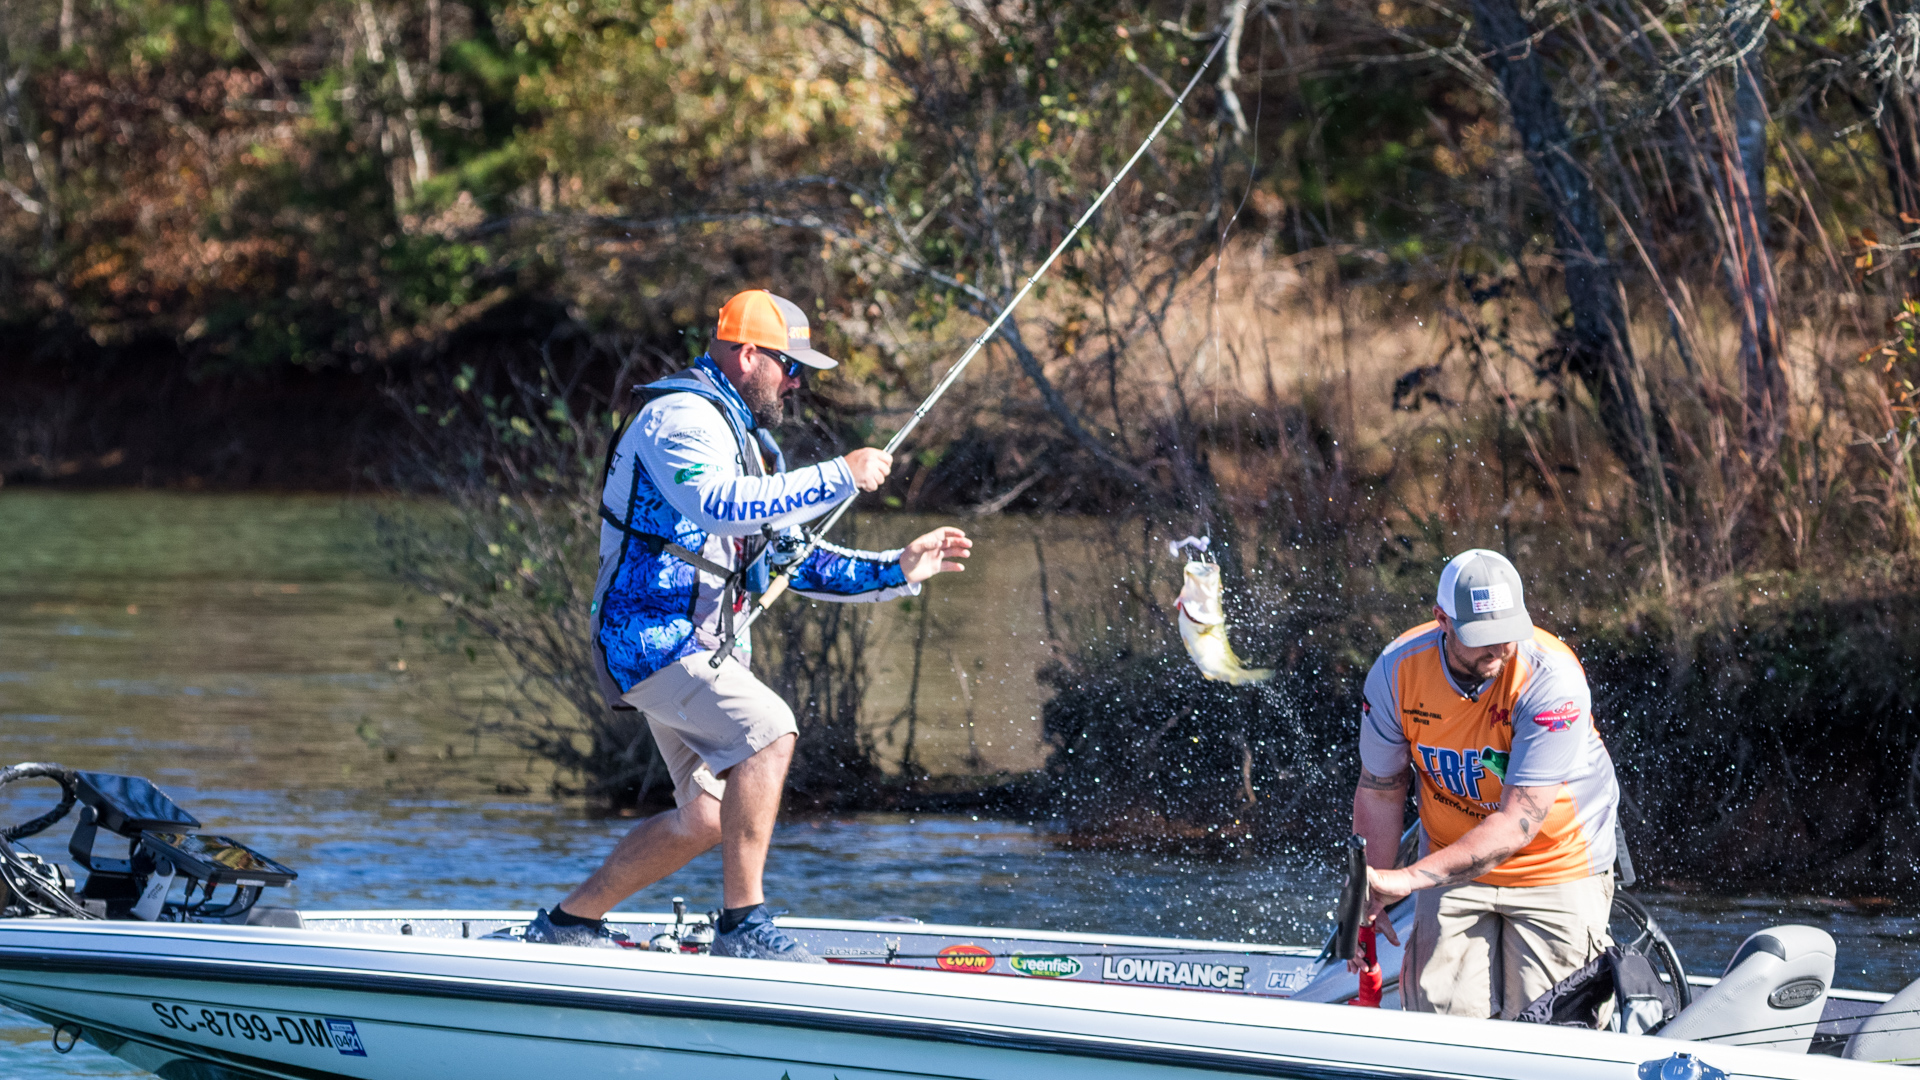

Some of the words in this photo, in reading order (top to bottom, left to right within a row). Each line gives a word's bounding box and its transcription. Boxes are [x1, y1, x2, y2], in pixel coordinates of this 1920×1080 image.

[1416, 743, 1485, 801] TBF
[946, 950, 987, 967] ZOOM
[1011, 952, 1077, 973] Greenfish
[1102, 957, 1245, 989] LOWRANCE
[152, 1002, 334, 1048] SC-8799-DM
